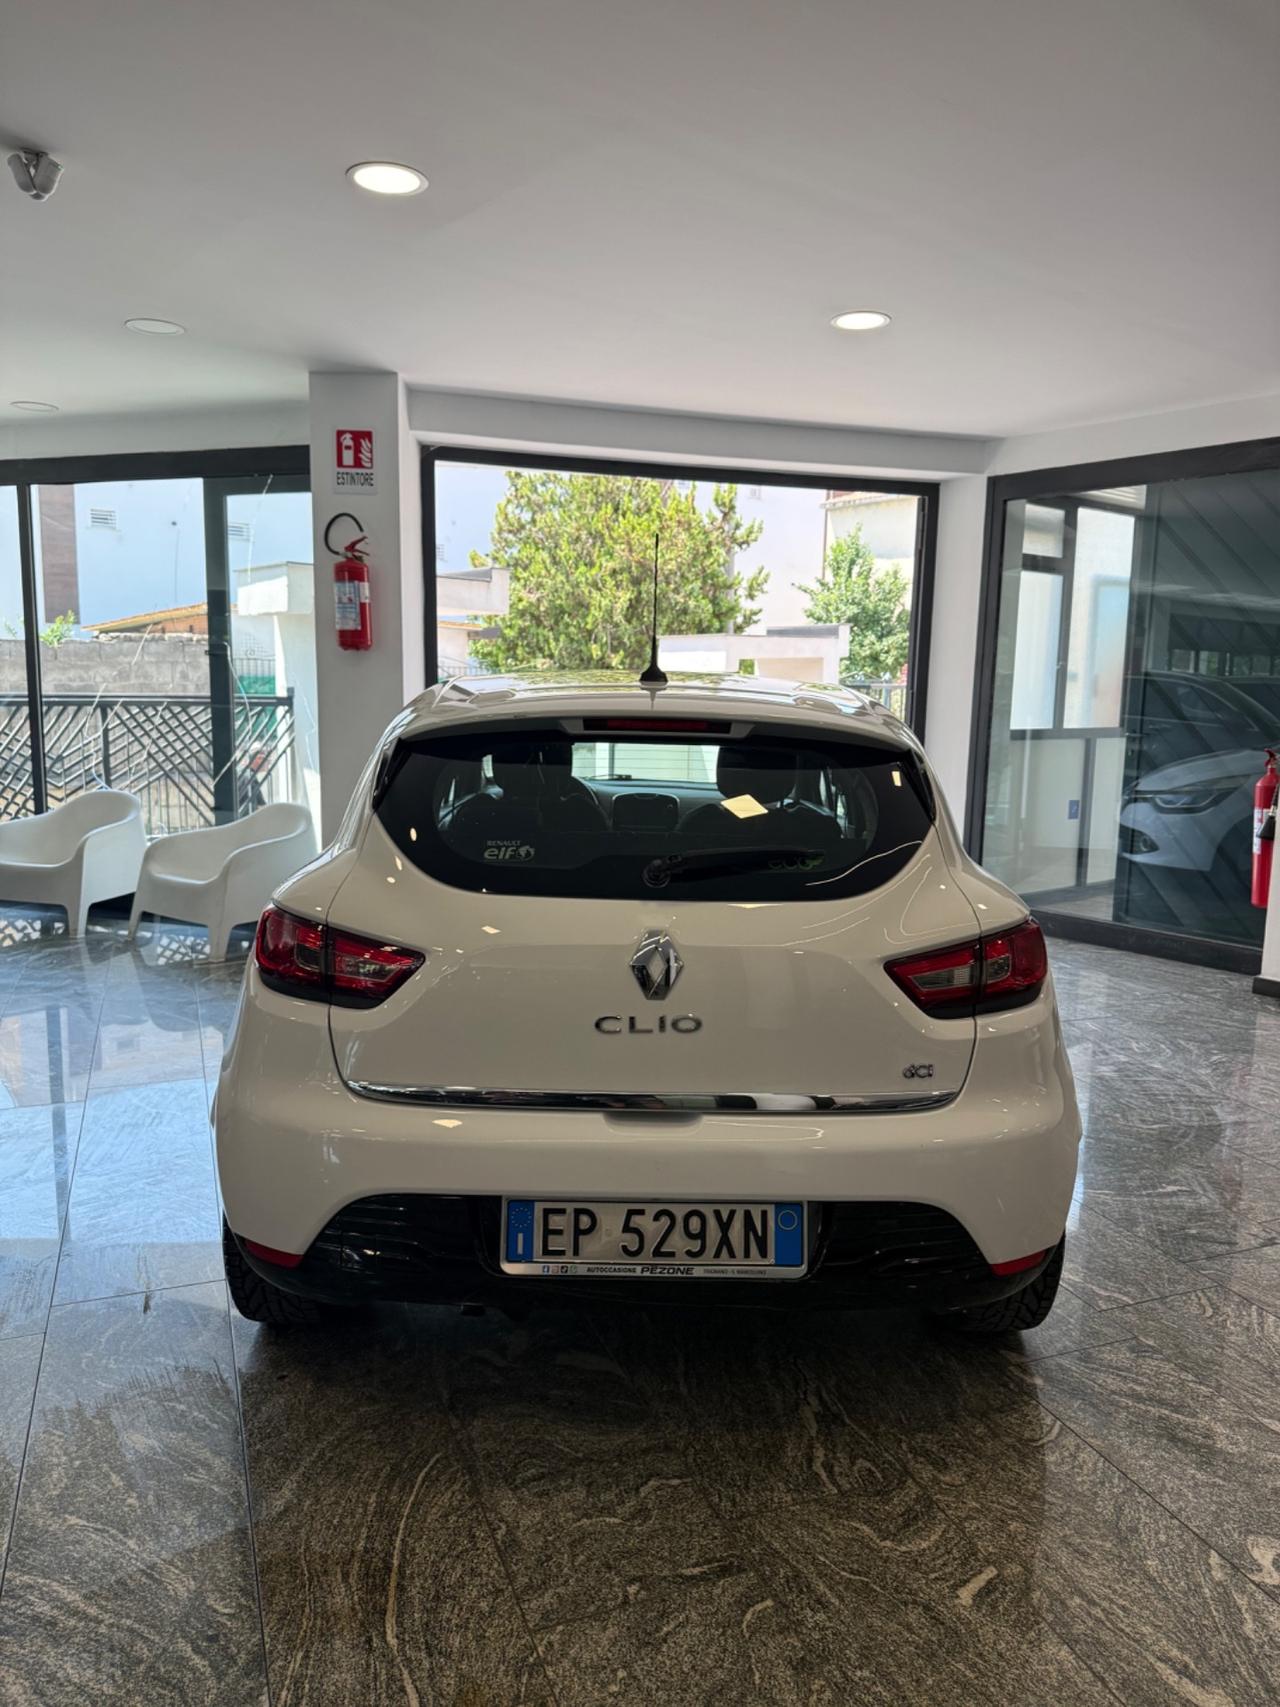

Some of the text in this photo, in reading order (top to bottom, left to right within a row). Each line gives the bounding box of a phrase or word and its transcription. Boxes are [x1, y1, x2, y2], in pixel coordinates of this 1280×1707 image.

[336, 472, 374, 486] ESTINTORE
[484, 847, 516, 859] elf
[595, 1016, 703, 1034] CLIO
[542, 1208, 768, 1259] EP 529XN
[640, 1267, 695, 1276] PEZONE
